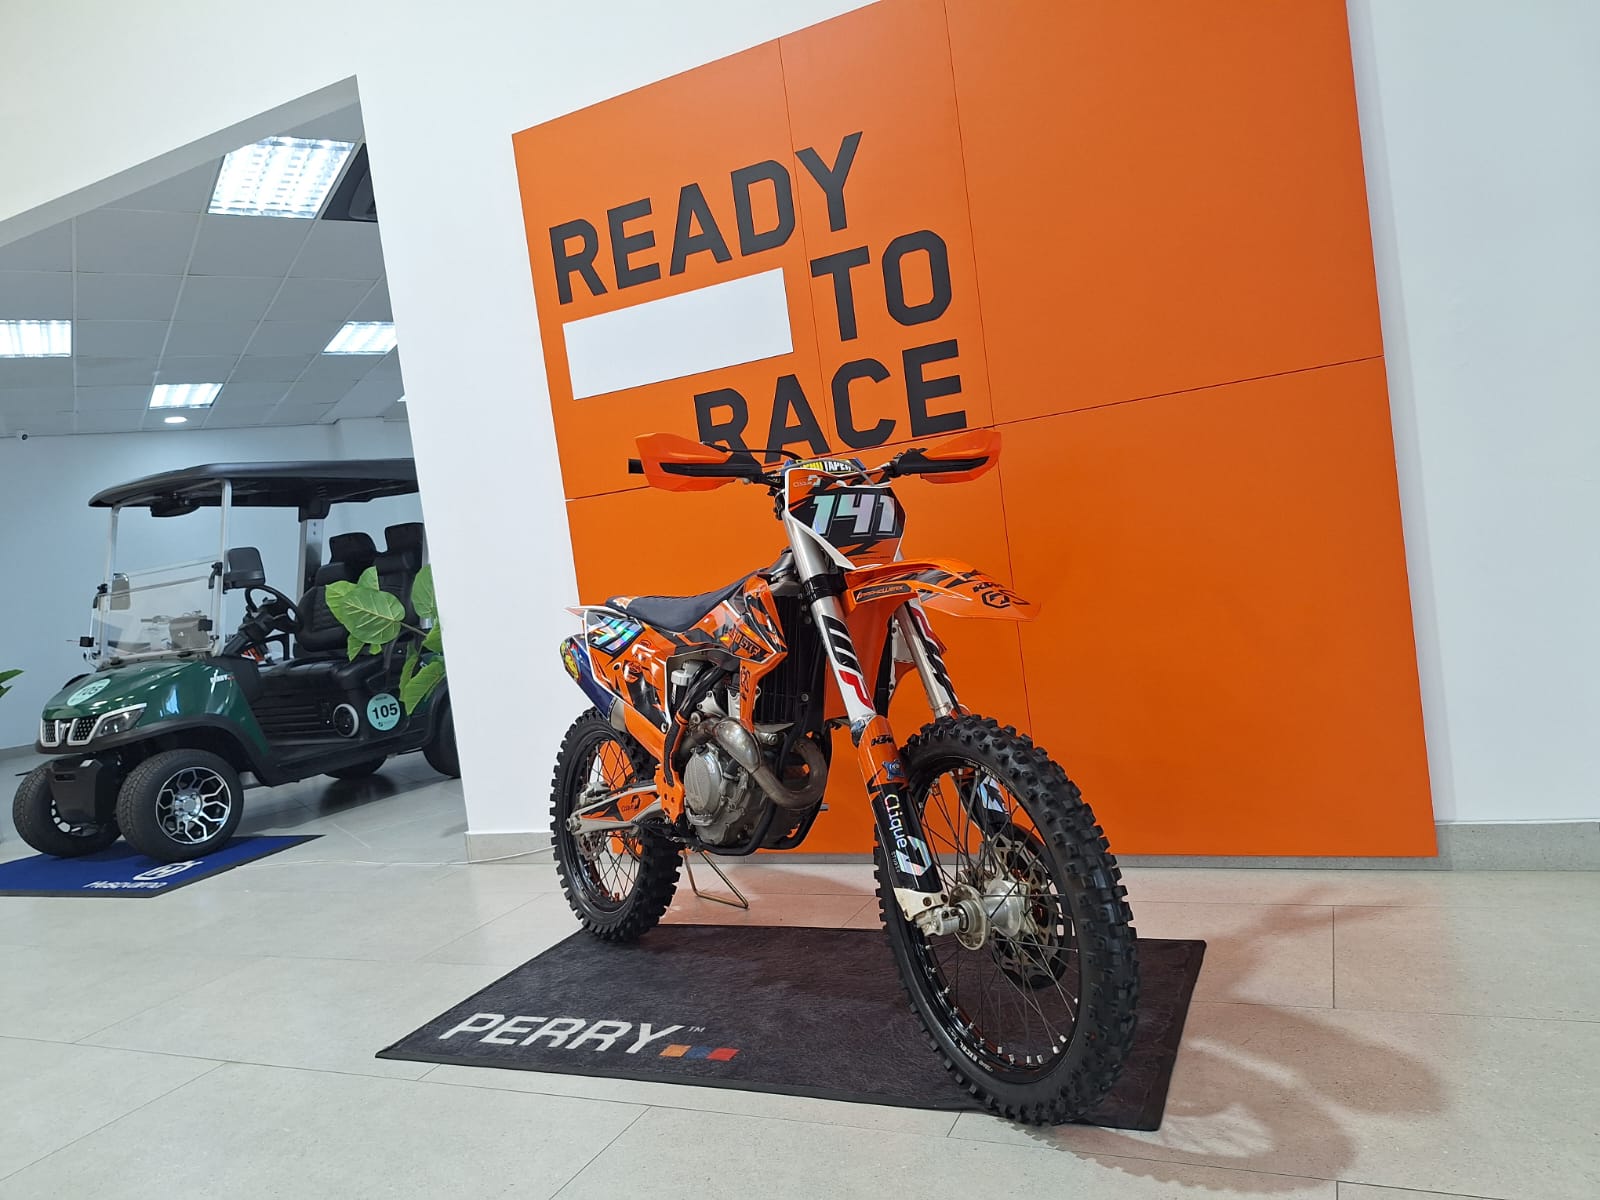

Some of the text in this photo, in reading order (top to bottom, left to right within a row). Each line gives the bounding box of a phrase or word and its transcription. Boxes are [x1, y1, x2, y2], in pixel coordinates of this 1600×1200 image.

[549, 131, 863, 305] READY
[810, 230, 952, 342] TO
[694, 339, 967, 464] RACE
[811, 493, 897, 538] 141
[372, 703, 398, 720] 105
[884, 794, 907, 850] Clique
[439, 1012, 685, 1054] PERRY
